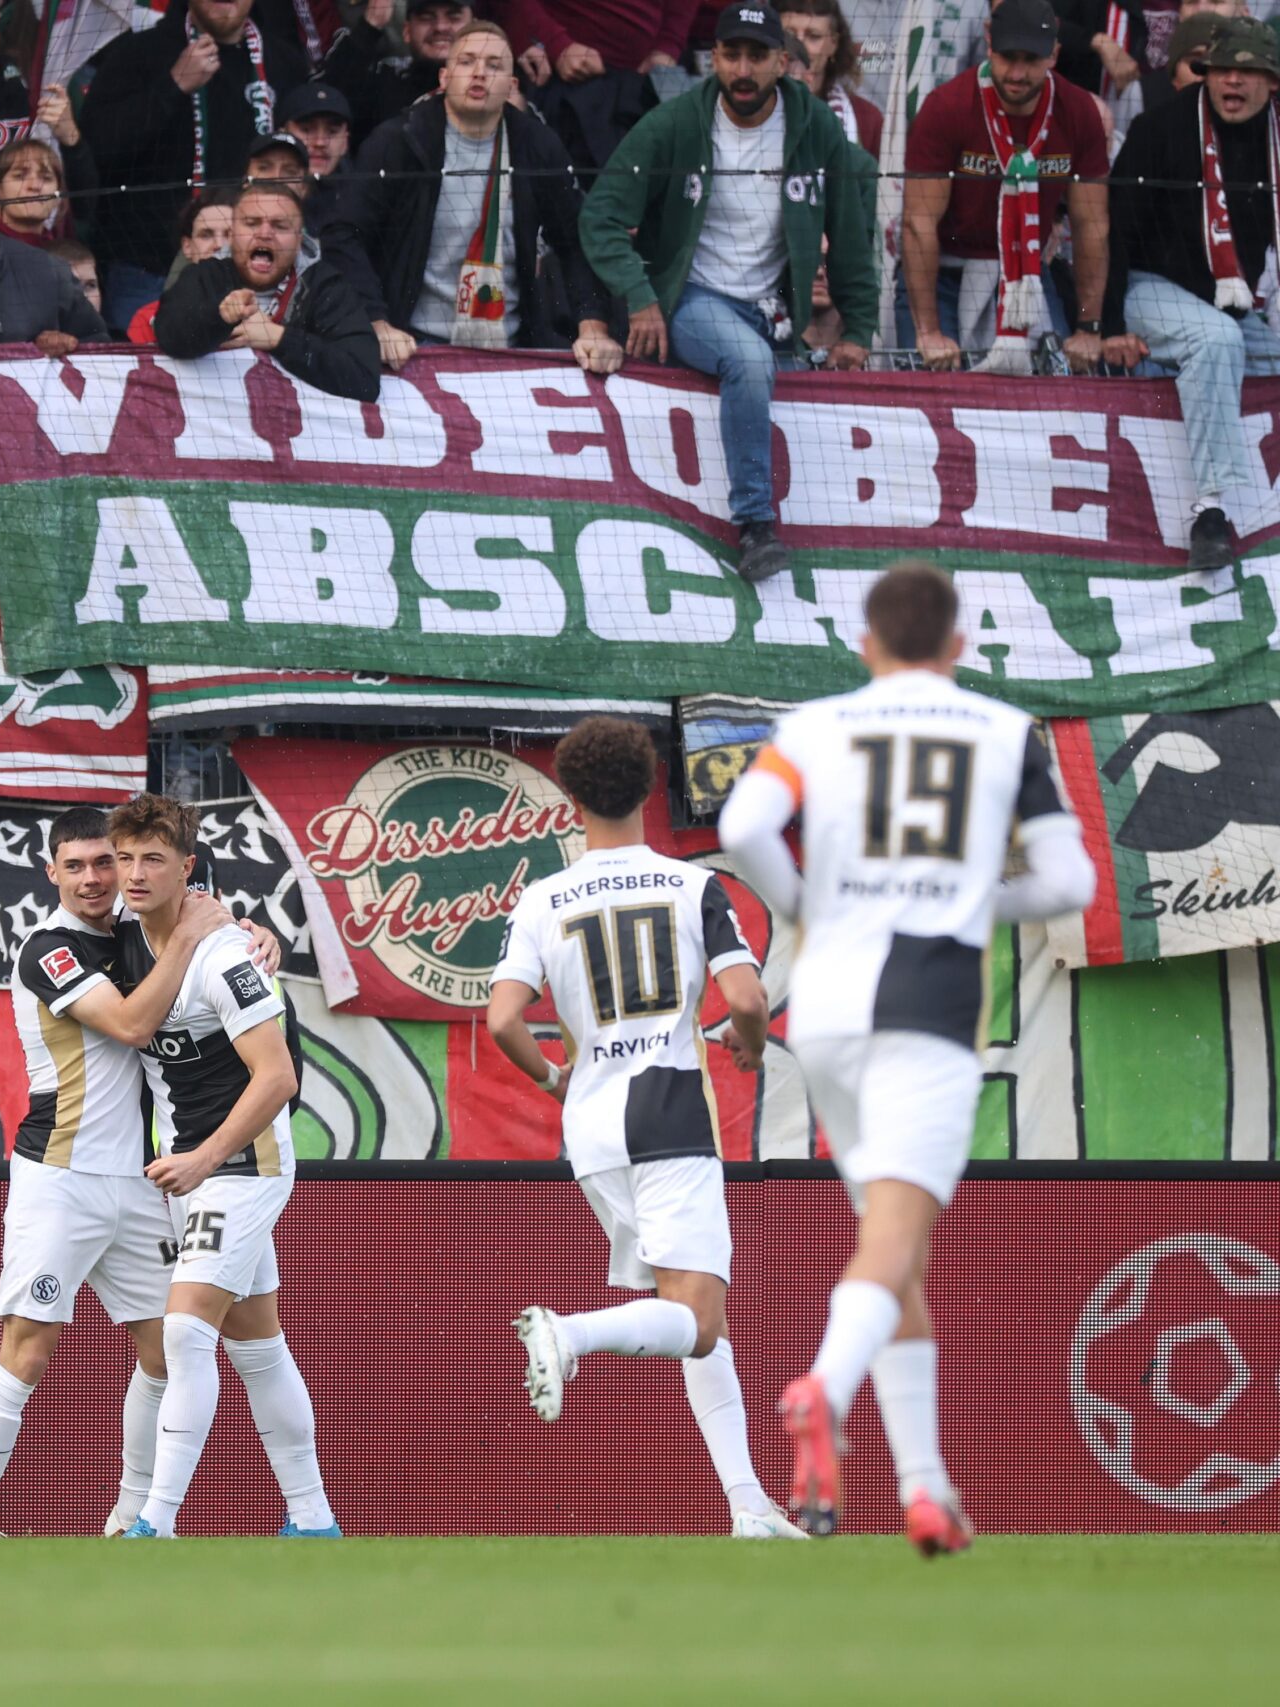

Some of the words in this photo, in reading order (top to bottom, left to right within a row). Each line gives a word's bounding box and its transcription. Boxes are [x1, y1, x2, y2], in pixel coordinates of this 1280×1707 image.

[75, 496, 1280, 680] ABSCHAF
[394, 750, 444, 776] THE
[451, 748, 510, 777] KIDS
[850, 733, 977, 862] 19
[342, 857, 526, 955] Augsb
[550, 873, 684, 910] ELVERSBERG
[409, 963, 452, 997] ARE
[560, 901, 683, 1028] 10
[181, 1210, 227, 1253] 25
